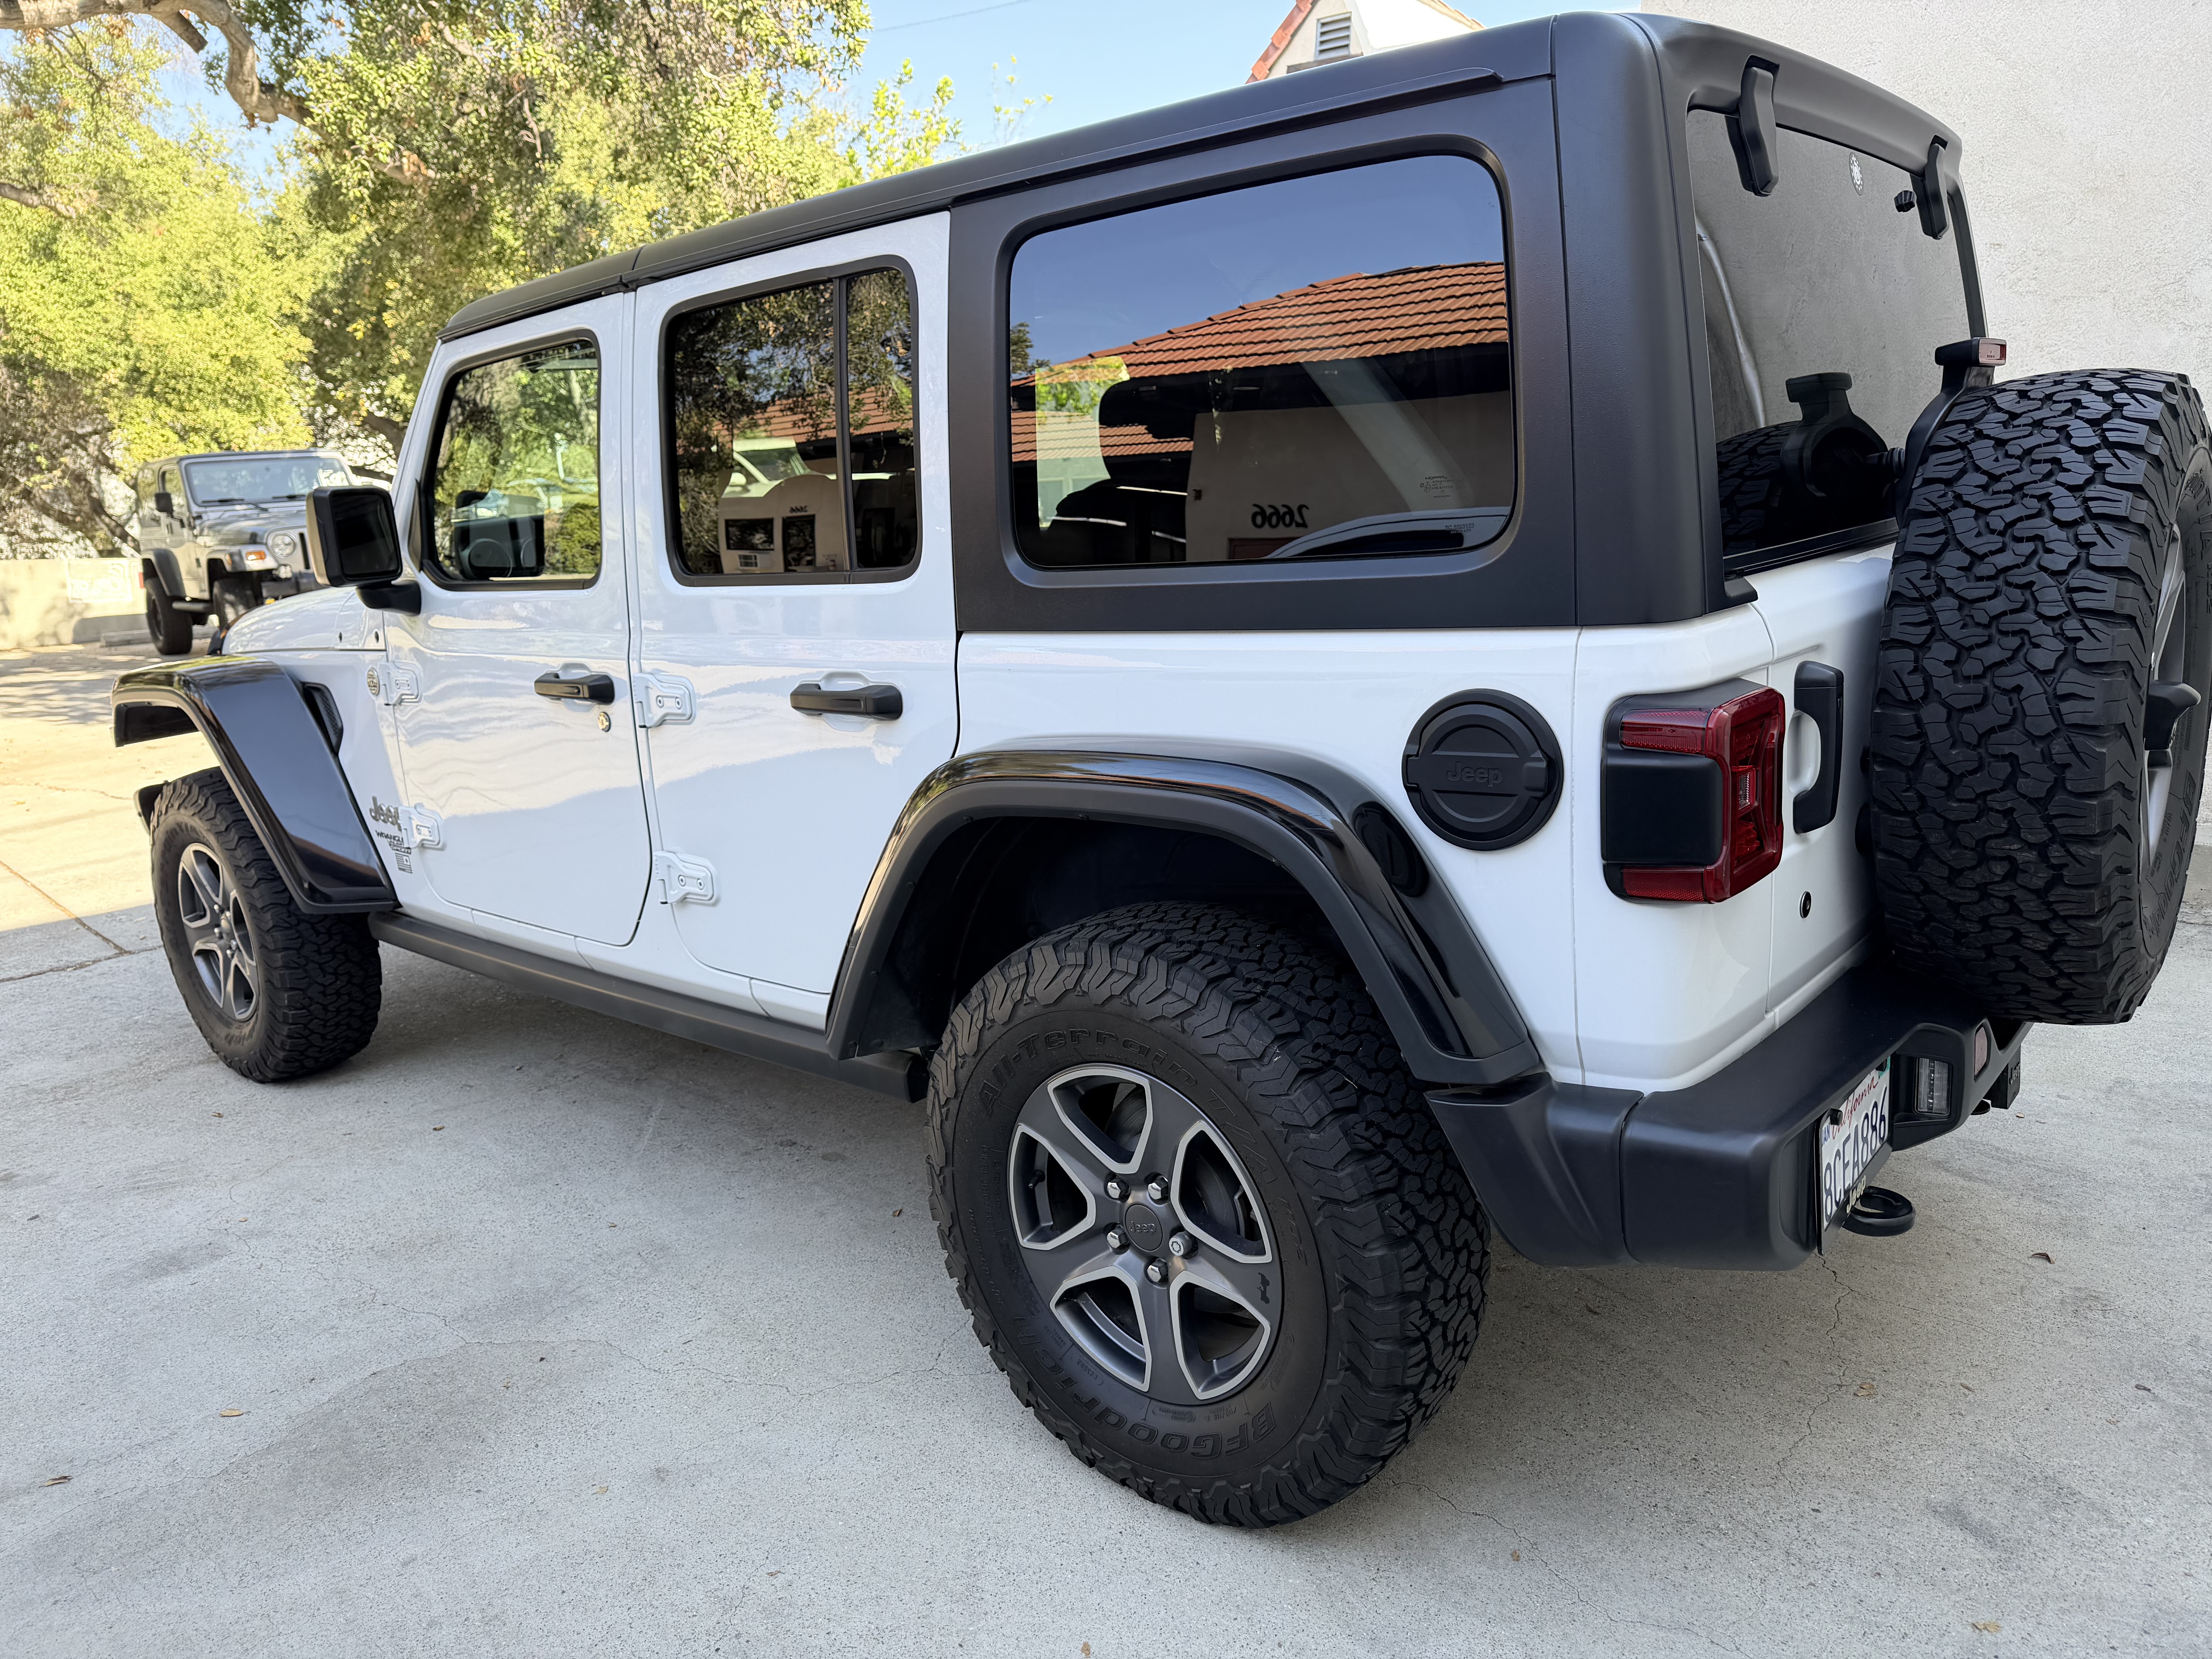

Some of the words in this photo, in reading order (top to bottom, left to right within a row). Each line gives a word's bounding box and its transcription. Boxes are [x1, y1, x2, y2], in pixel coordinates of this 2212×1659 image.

[1446, 761, 1503, 787] Jeep
[2142, 770, 2196, 939] BFGood
[978, 1028, 1198, 1118] All-Terrain
[1824, 1085, 1887, 1223] 8CEA886
[1846, 1175, 1867, 1214] Jeep
[1129, 1221, 1157, 1236] Jeep
[1013, 1316, 1276, 1460] BFGoodrich
